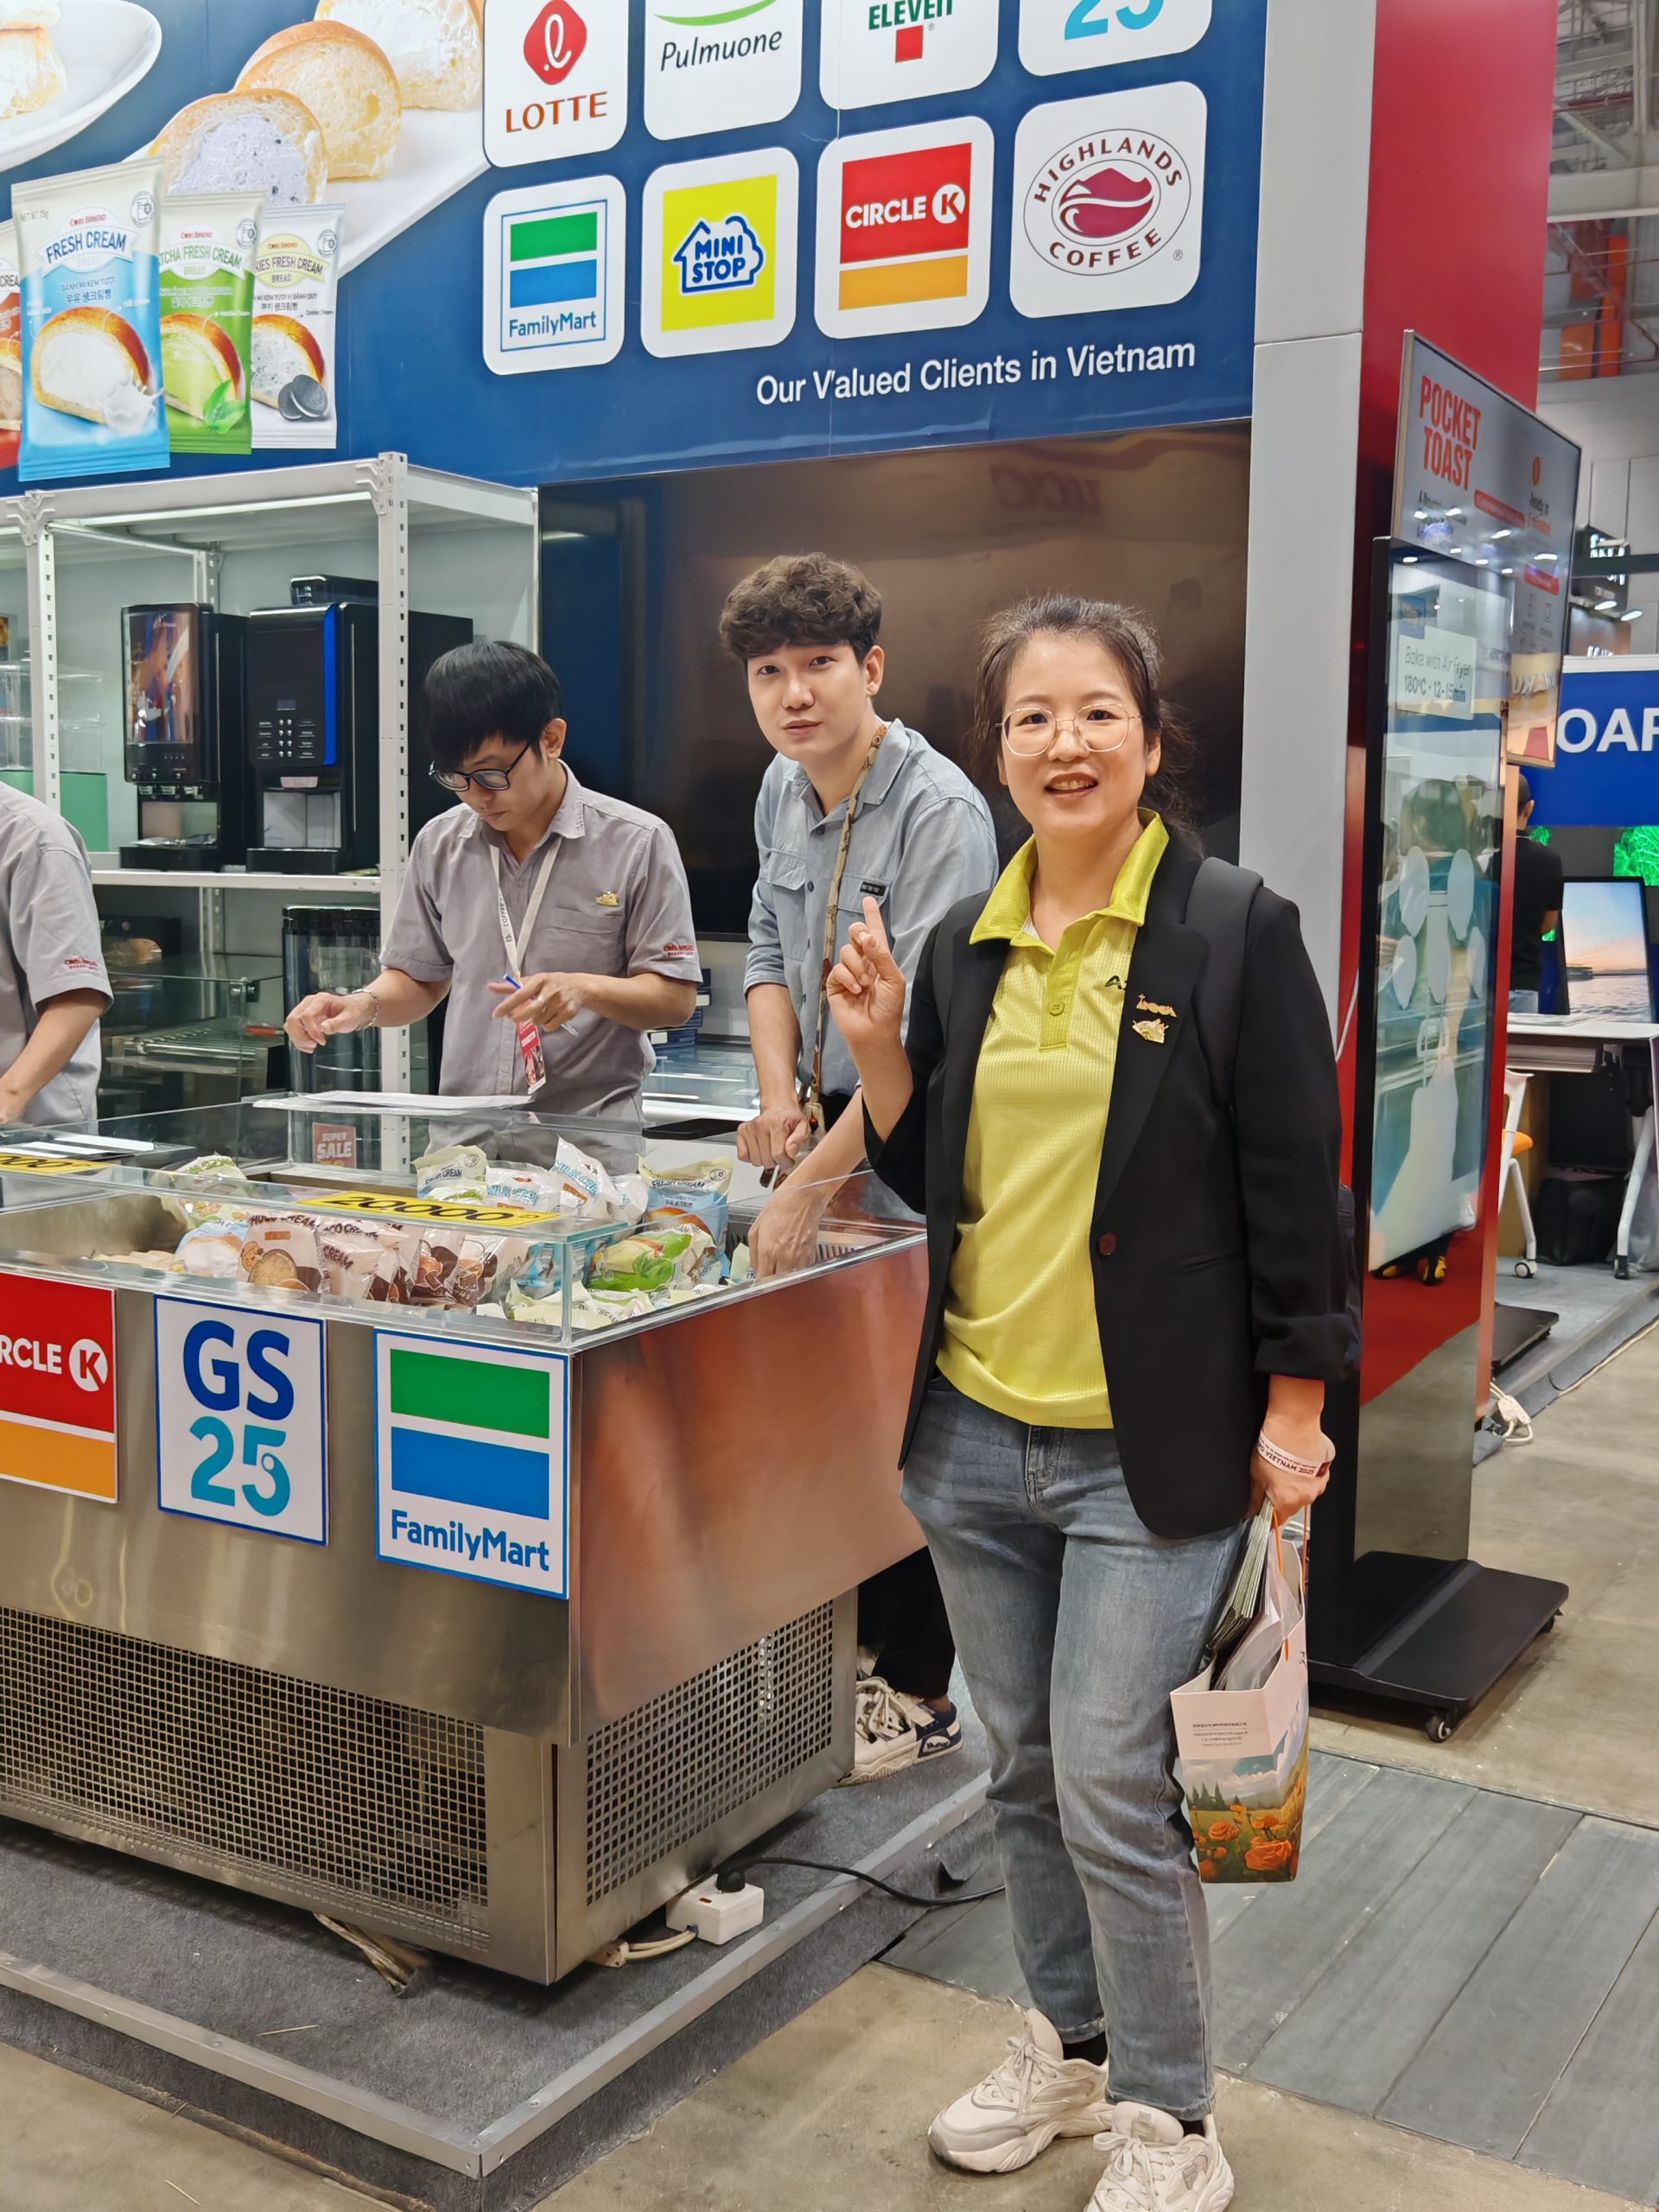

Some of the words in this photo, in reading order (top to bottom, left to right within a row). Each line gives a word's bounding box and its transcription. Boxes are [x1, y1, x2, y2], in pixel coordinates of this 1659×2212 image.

[660, 30, 783, 72] Pulmuone
[505, 92, 607, 133] LOTTE
[1034, 137, 1182, 202] HIGHLANDS
[845, 196, 926, 228] CIRCLE
[46, 233, 84, 264] FRESH
[86, 230, 128, 252] CREAM
[159, 248, 182, 267] TCHA
[182, 245, 211, 262] FRESH
[213, 246, 243, 269] CREAM
[695, 234, 743, 259] MINI
[1049, 228, 1162, 268] COFFEE
[0, 274, 21, 288] CREA
[271, 256, 296, 270] FRESH
[297, 257, 324, 276] CREAM
[271, 275, 292, 283] BREAD
[692, 257, 746, 283] STOP
[509, 311, 596, 338] FamilyMart
[757, 373, 806, 405] Our
[813, 364, 911, 399] Valued
[920, 356, 1021, 389] Clients
[1031, 351, 1057, 380] in
[1066, 342, 1196, 376] Vietnam
[1419, 374, 1483, 450] POCKET
[1423, 426, 1473, 491] TOAST
[1404, 645, 1425, 667] Bake
[316, 1141, 353, 1159] SALE
[322, 1244, 354, 1270] CREAM
[183, 1319, 295, 1421] GS
[190, 1415, 290, 1517] 25
[1266, 1451, 1297, 1471] VIETNAM
[391, 1509, 550, 1573] FamilyMart
